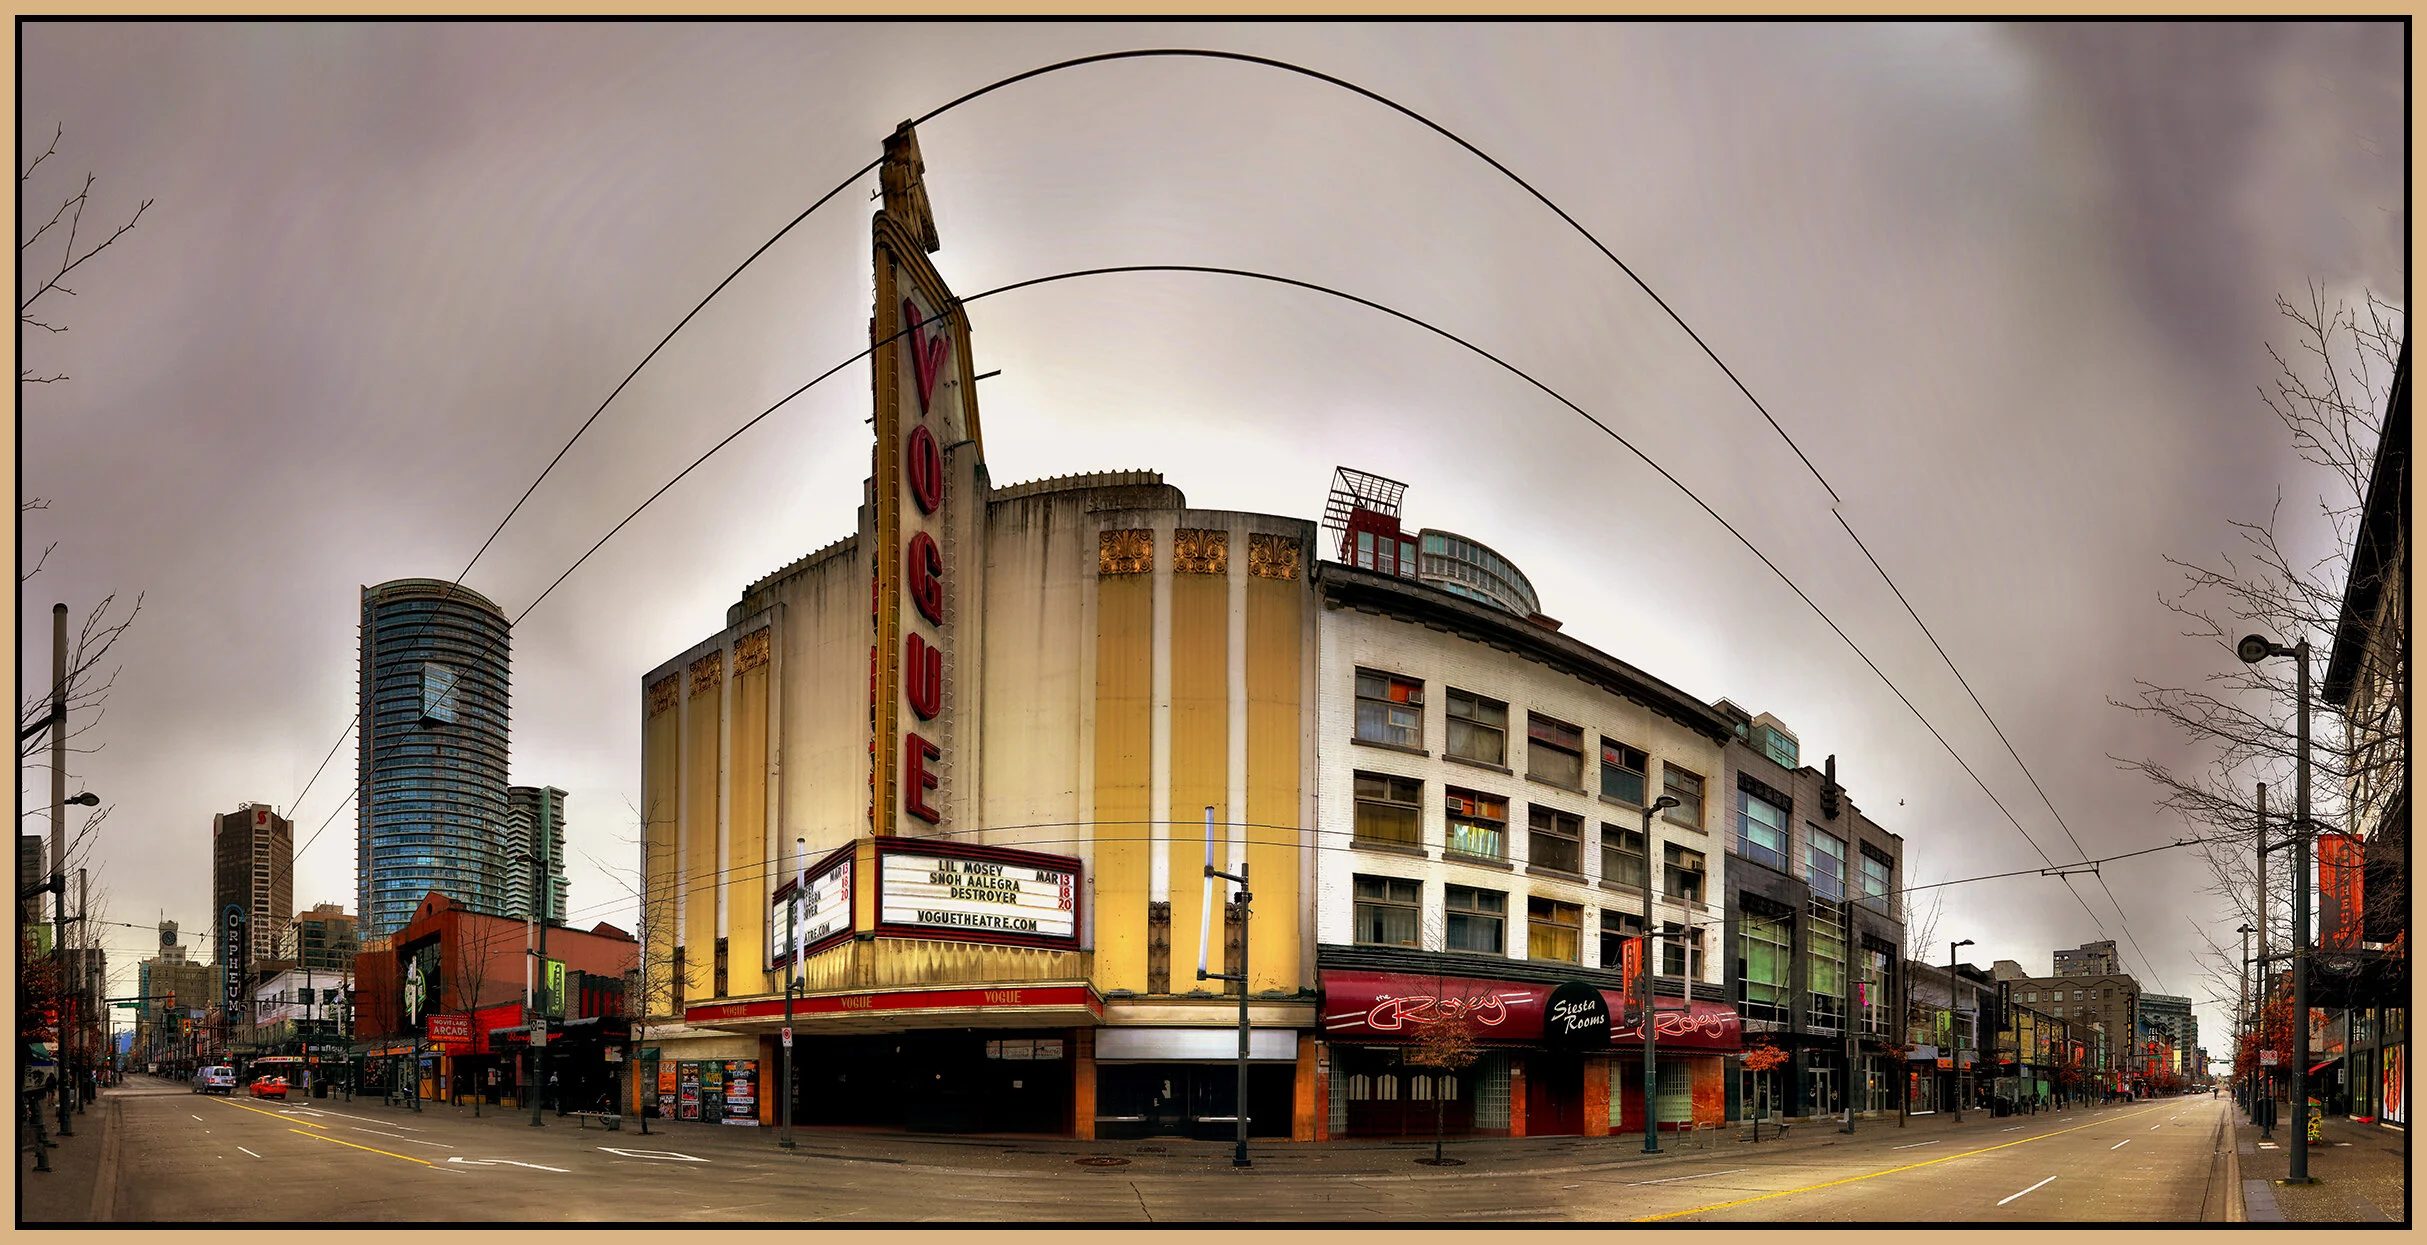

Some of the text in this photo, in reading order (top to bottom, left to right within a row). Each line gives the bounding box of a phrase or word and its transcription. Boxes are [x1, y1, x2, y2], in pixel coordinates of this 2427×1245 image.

[904, 296, 950, 825] VOGUE
[829, 863, 848, 882] MAR 13
[938, 860, 1003, 877] LIL MOSEY
[842, 876, 848, 888] 18
[929, 872, 1020, 892] SNOH AALEGRA
[1035, 870, 1070, 886] MAR 13
[841, 888, 848, 901] 20
[950, 886, 1017, 904] DESTROYER
[1059, 886, 1070, 898] 18
[1058, 899, 1072, 911] 20
[917, 910, 1037, 931] VOGUETHEATRE.COM
[229, 914, 239, 1011] ORPHEUM
[841, 995, 873, 1009] VOGUE
[984, 990, 1022, 1004] VOGUE
[1375, 994, 1391, 1002] the
[722, 1004, 748, 1016] VOGUE
[1367, 994, 1507, 1031] Roxy
[1551, 999, 1595, 1022] Siesta
[433, 1026, 468, 1036] ARCADE
[1563, 1014, 1605, 1035] Rooms
[1637, 1012, 1724, 1041] Roxy
